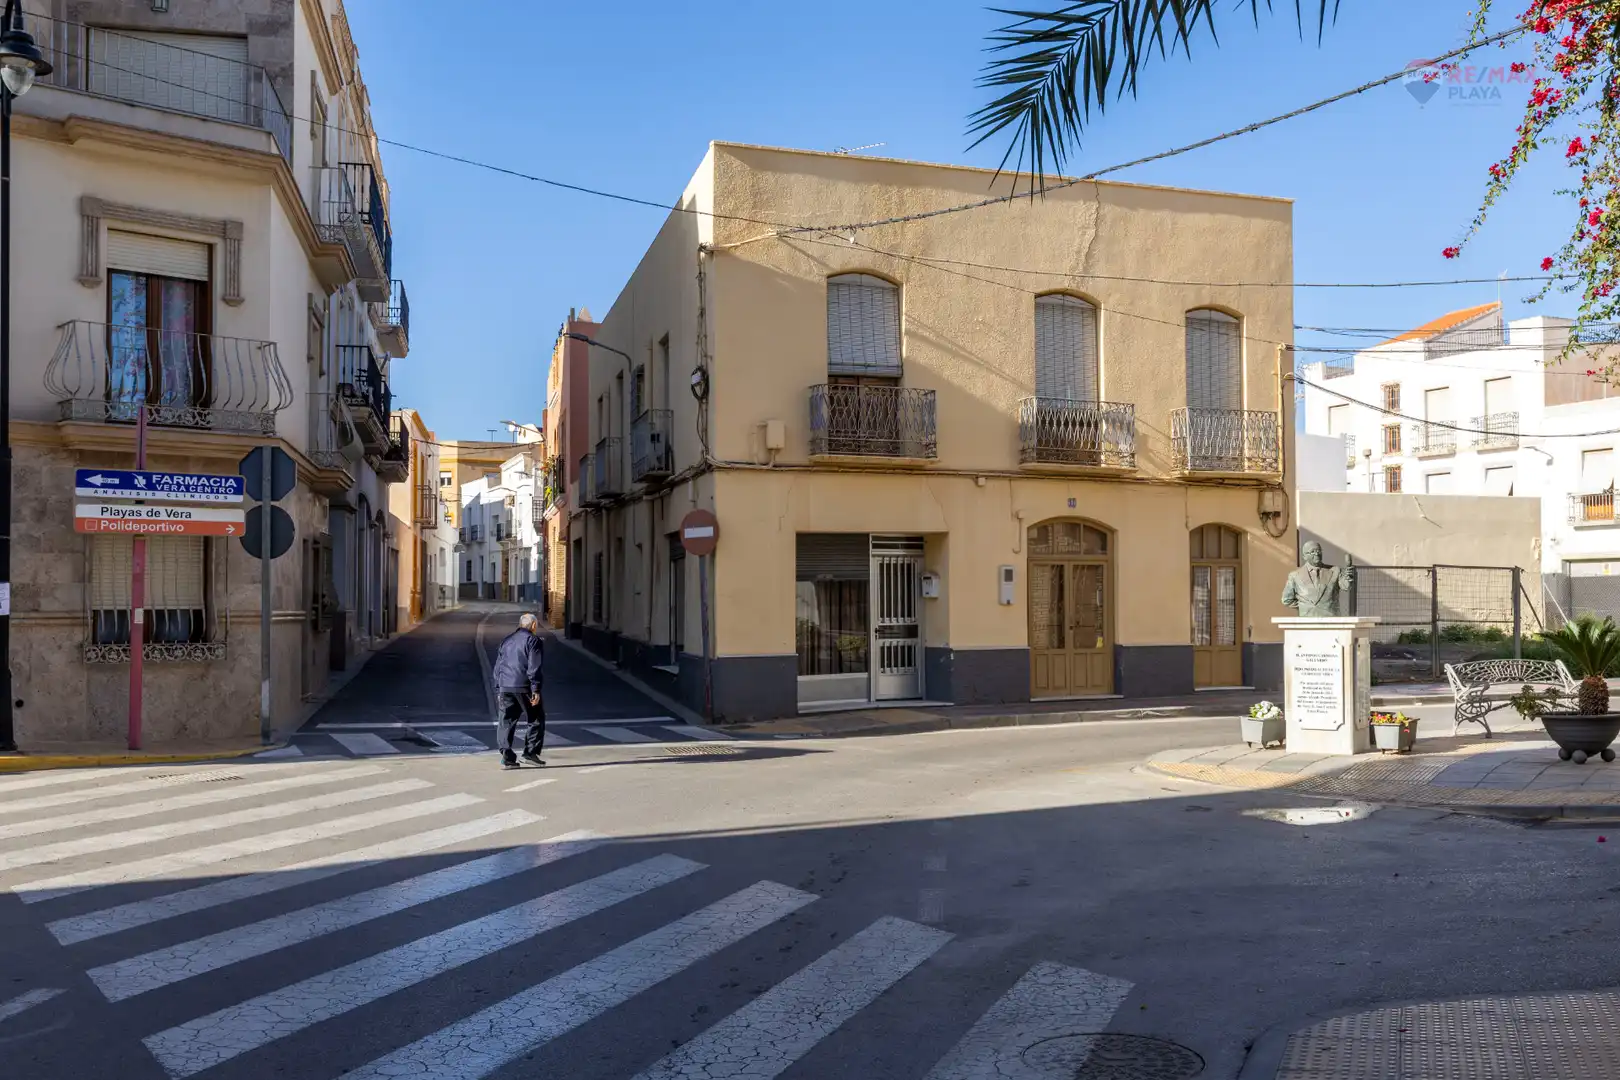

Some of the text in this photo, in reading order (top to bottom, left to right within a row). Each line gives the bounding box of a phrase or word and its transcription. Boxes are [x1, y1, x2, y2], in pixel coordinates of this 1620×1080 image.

[152, 474, 237, 488] FARMACIA
[156, 484, 235, 494] VERA CENTRO
[100, 506, 192, 519] Playas de Vera
[100, 520, 185, 532] Polideportivo
